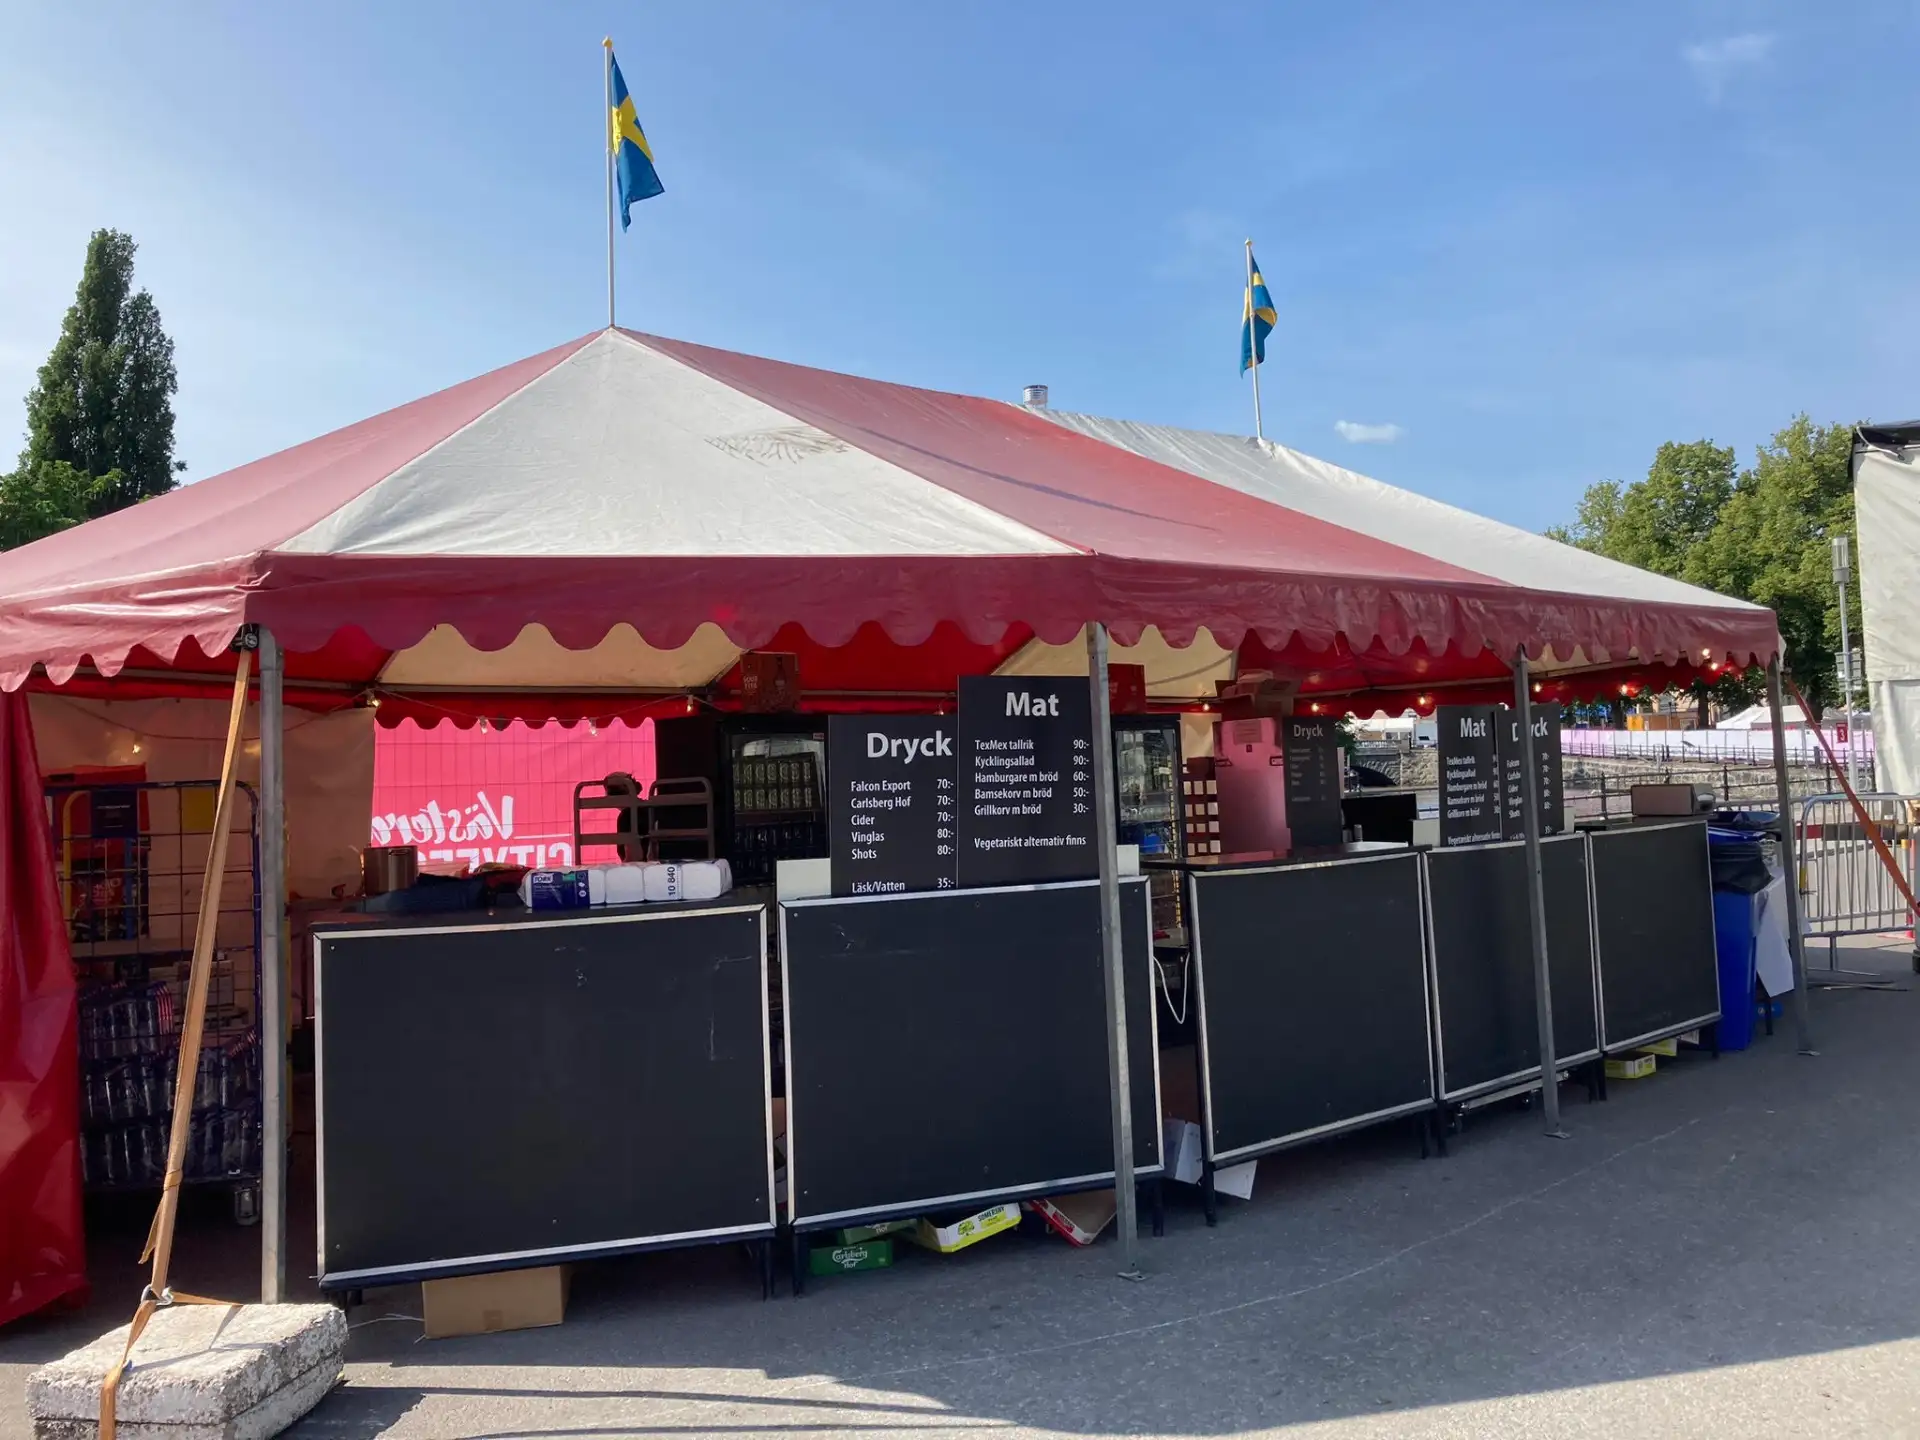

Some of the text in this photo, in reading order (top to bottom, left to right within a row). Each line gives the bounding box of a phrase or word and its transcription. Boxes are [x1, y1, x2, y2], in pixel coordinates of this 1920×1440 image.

[1005, 692, 1059, 717] Mat
[1293, 724, 1323, 740] Dryck
[1460, 717, 1486, 738] Mat
[867, 730, 953, 764] Dryck
[975, 739, 1090, 750] TexMex tallrik 90:-
[975, 756, 1090, 768] Kycklingsallad 90:-
[975, 771, 1090, 784] Hamburgare m bröd 60:-
[851, 779, 954, 793] Falcon Export 70:-
[975, 788, 1021, 799] Bamsekorv
[1033, 787, 1052, 798] bröd
[1073, 788, 1090, 797] 50:-
[851, 795, 954, 810] Carlsberg Hof 70:-
[975, 804, 1011, 816] Grillkorv
[1022, 804, 1041, 814] bröd
[1072, 804, 1089, 814] 30:-
[851, 812, 954, 825] Cider 70:-
[852, 829, 954, 844] Vinglas 80:-
[975, 835, 1086, 849] Vegetariskt alternativ finns
[852, 845, 954, 859] Shots 80:-
[668, 866, 676, 884] 840
[852, 878, 955, 893] Läsk/Vatten 35:-
[832, 1246, 868, 1262] Carlsberg
